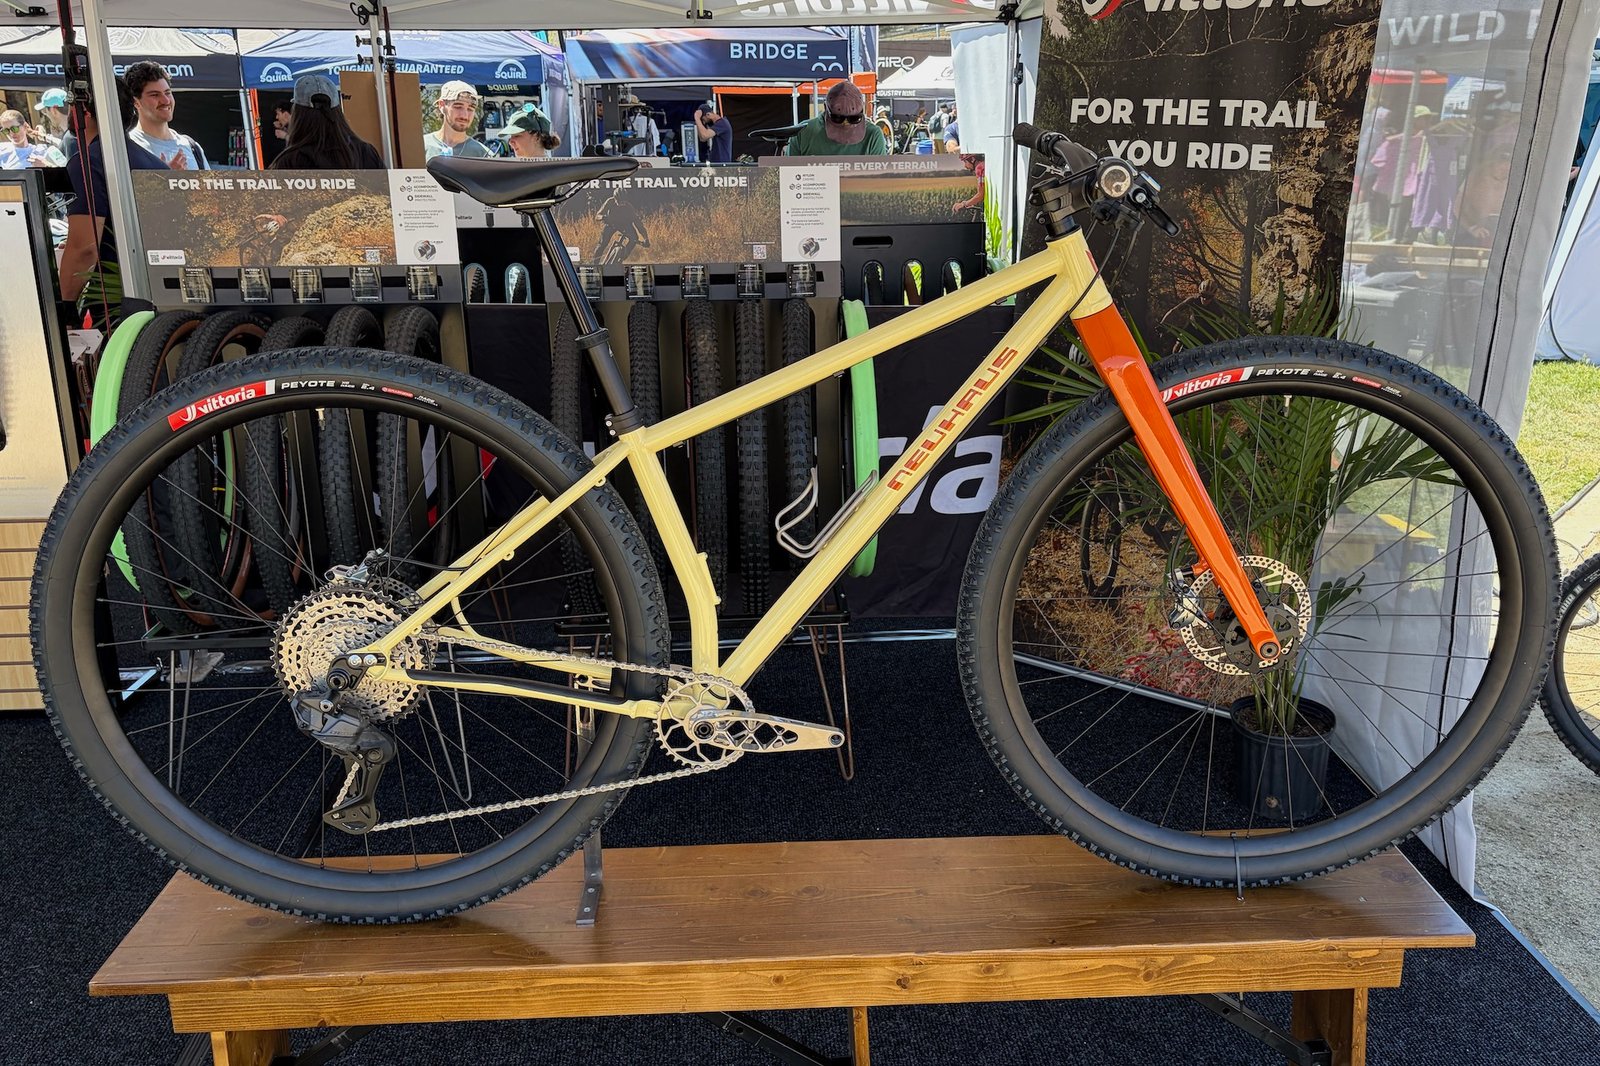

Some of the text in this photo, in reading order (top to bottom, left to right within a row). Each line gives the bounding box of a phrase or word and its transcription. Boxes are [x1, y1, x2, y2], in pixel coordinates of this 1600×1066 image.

[1388, 11, 1506, 46] WILD
[730, 43, 808, 60] BRIDGE
[394, 63, 465, 75] GUARANTEED
[495, 71, 527, 79] SQUIRE
[260, 74, 293, 83] SQUIRE
[487, 84, 520, 92] SQUIRE
[1070, 98, 1326, 129] FOR THE TRAIL
[1107, 140, 1273, 172] YOU RIDE
[854, 162, 889, 171] EVERY
[891, 161, 938, 170] TERRAIN
[168, 179, 356, 190] FOR THE TRAIL YOU RIDE
[603, 178, 632, 188] THE
[635, 178, 677, 188] TRAIL
[680, 177, 710, 188] YOU
[714, 177, 748, 188] RIDE
[1174, 368, 1311, 398] vittoria PEYOTE
[197, 380, 336, 414] vittoria PEYOTE
